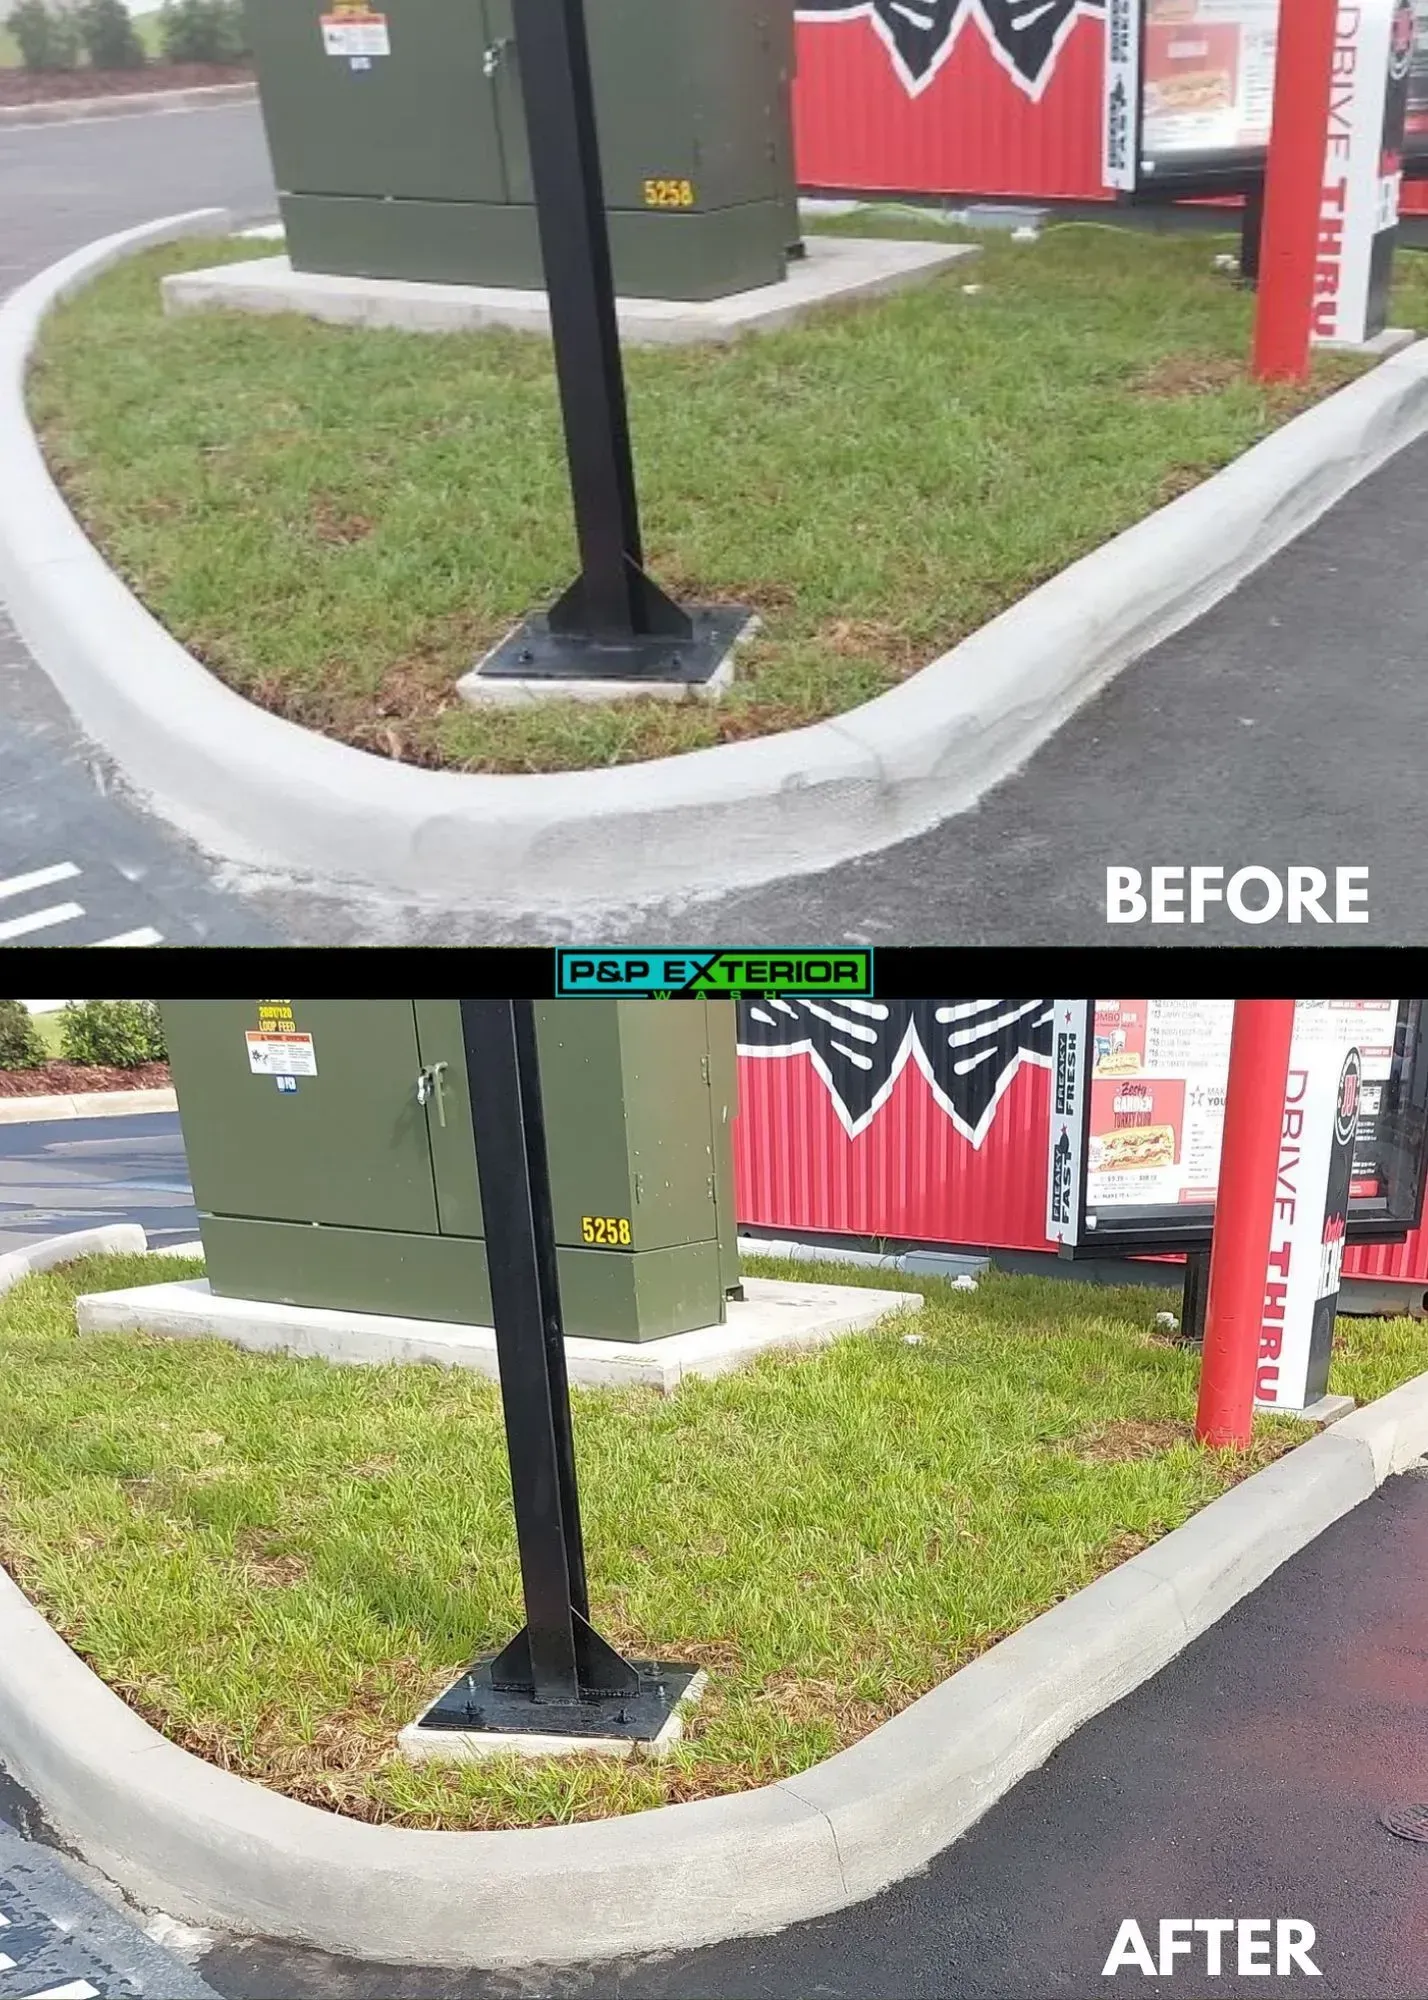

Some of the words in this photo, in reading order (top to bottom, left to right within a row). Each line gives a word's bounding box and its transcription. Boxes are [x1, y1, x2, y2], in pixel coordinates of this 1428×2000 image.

[1327, 7, 1361, 161] DRIVE
[644, 180, 694, 206] 5258
[1313, 177, 1348, 336] THRU
[278, 1021, 296, 1032] FEED
[1095, 1012, 1120, 1021] OMBO
[1057, 1036, 1067, 1111] FREAKY
[1066, 1033, 1077, 1116] FRESH
[1121, 1082, 1148, 1098] Zesty
[1207, 1087, 1225, 1095] MAK
[1207, 1097, 1226, 1106] YOU
[1053, 1148, 1062, 1217] FREAKY
[1274, 1070, 1309, 1226] DRIVE
[1061, 1149, 1072, 1224] FAST
[582, 1217, 632, 1245] 5258
[1255, 1241, 1291, 1402] THRU
